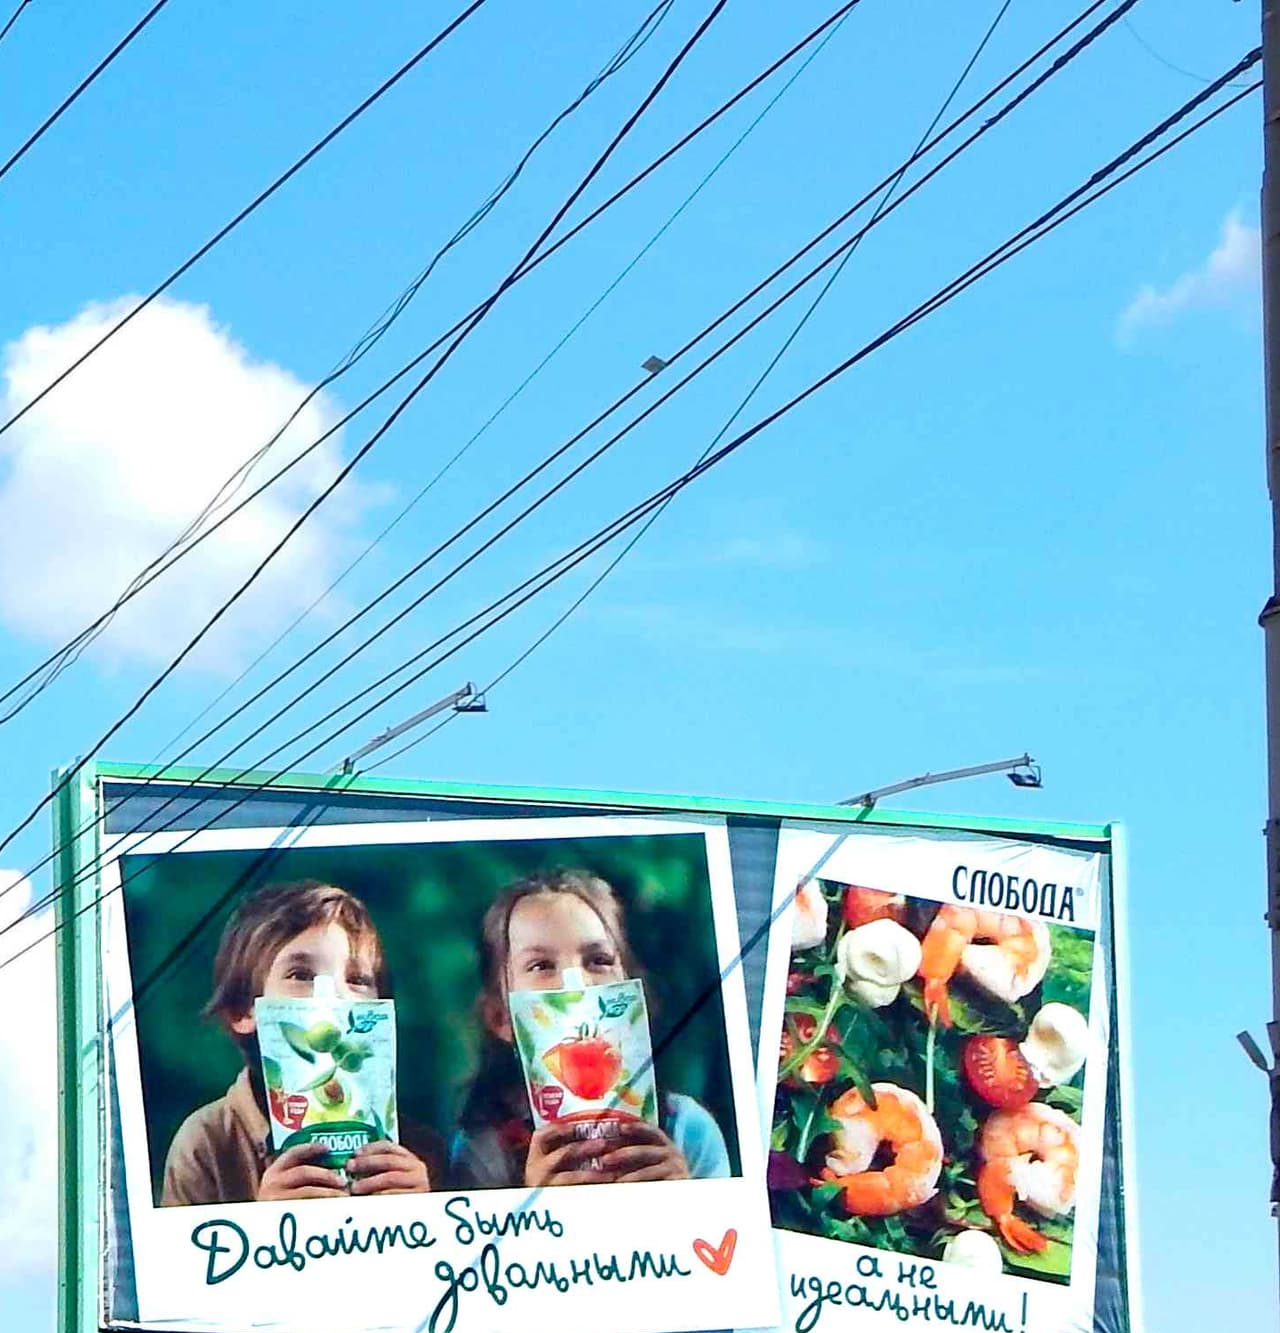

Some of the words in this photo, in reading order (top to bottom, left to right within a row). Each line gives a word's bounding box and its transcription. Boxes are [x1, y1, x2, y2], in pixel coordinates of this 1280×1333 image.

[575, 1121, 619, 1140] ЛОБОД
[192, 1213, 437, 1285] Давайте
[444, 1196, 564, 1245] быть
[856, 1255, 883, 1277] а
[897, 1261, 938, 1288] не
